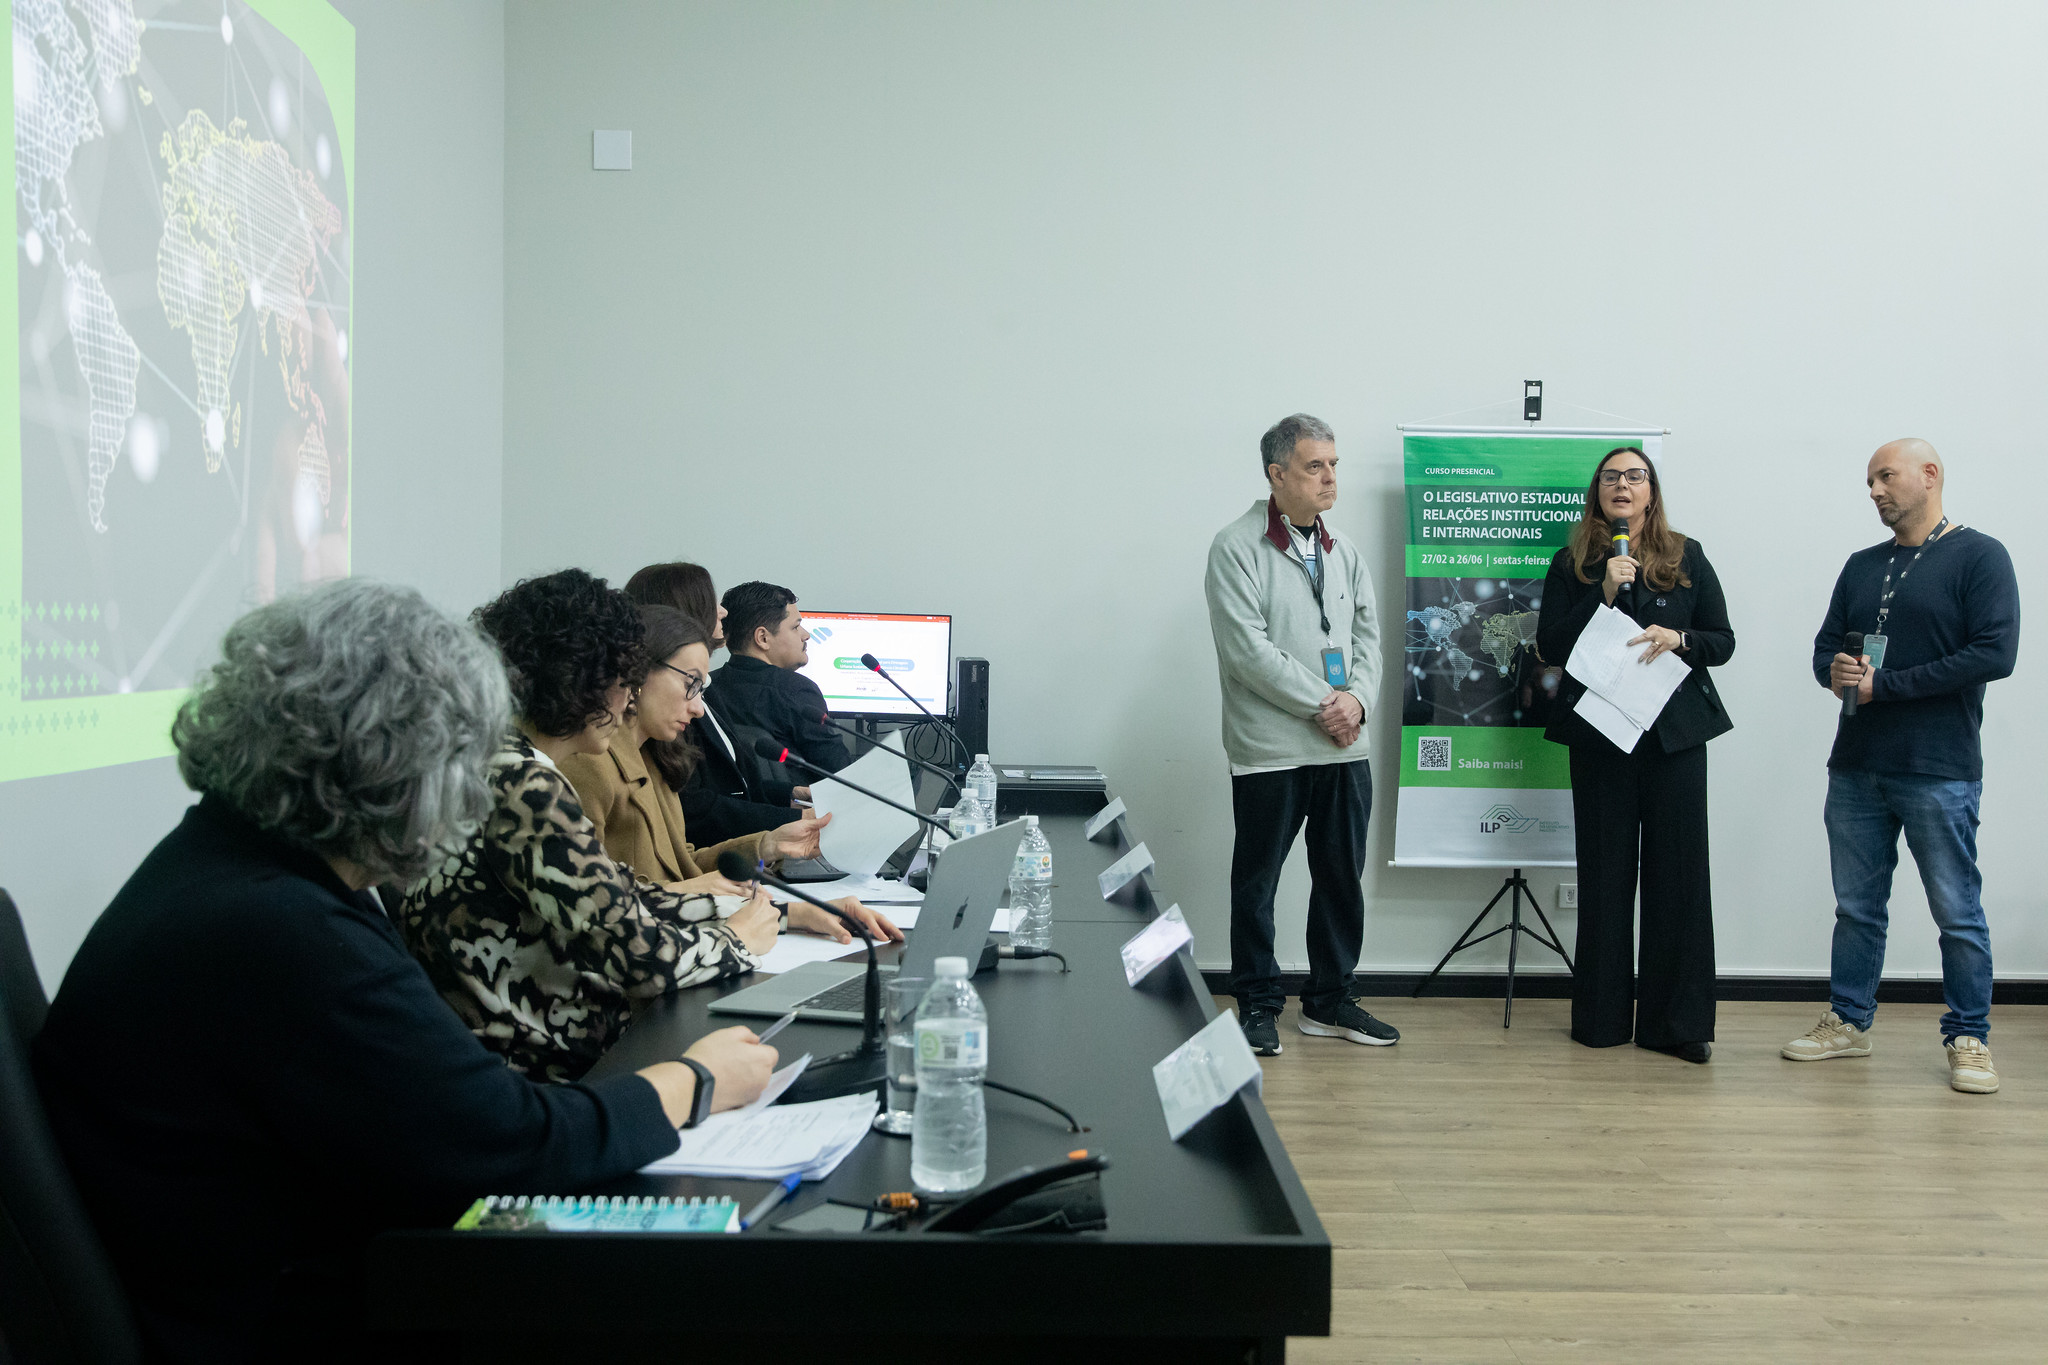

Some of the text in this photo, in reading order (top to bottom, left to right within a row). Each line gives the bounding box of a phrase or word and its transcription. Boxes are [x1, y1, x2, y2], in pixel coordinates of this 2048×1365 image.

[1425, 467, 1495, 476] CURSO PRESENCIAL
[1423, 491, 1586, 504] O LEGISLATIVO ESTADUAL
[1423, 507, 1585, 523] RELAÇÕES INSTITUCIONA
[1423, 527, 1542, 539] E INTERNACIONAIS
[1422, 554, 1447, 564] 27/02
[1457, 554, 1482, 565] 26/06
[1458, 758, 1523, 769] Saiba mais!
[1480, 822, 1500, 833] ILP
